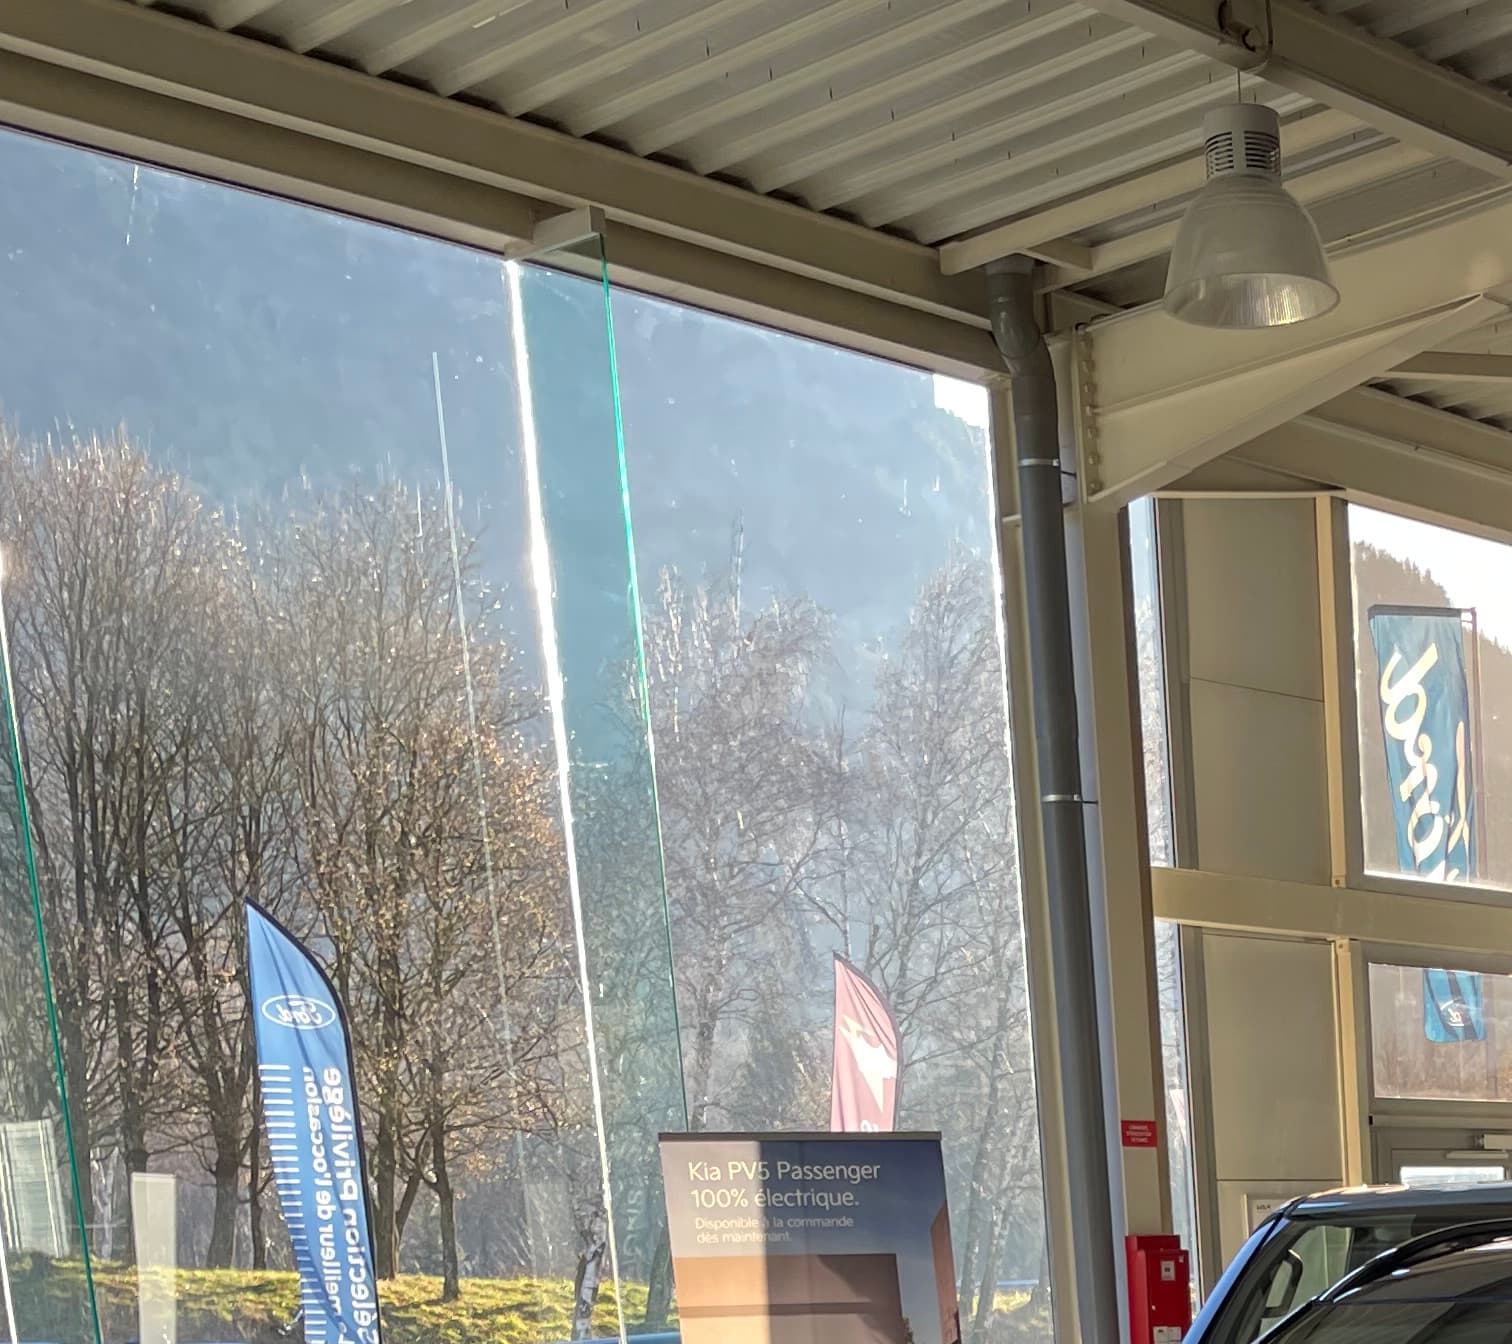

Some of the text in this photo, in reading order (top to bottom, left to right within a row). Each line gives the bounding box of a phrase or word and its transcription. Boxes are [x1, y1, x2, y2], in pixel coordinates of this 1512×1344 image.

[688, 1161, 881, 1184] Kia PV5 Passenger
[690, 1188, 860, 1211] 100% électrique.
[695, 1216, 760, 1230] Disponible
[773, 1216, 784, 1228] la
[787, 1216, 854, 1228] commande
